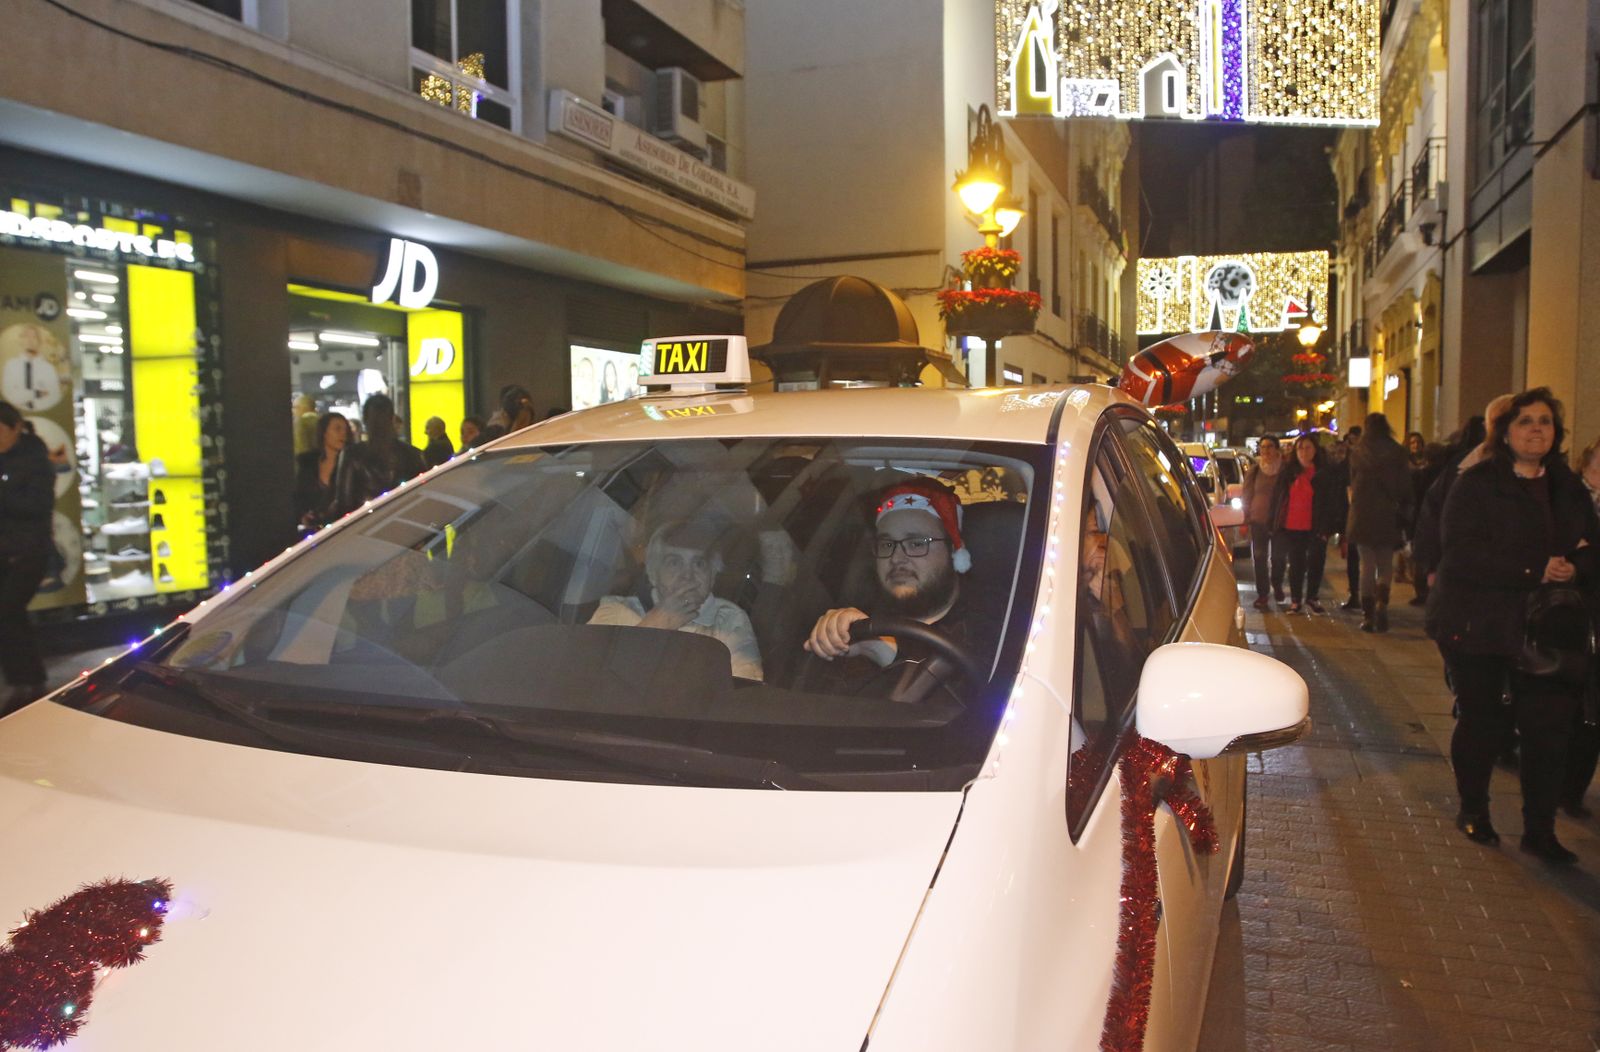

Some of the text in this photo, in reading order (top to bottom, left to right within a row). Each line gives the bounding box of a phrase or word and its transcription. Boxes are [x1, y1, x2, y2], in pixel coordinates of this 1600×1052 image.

[372, 238, 439, 309] JD
[35, 298, 60, 316] JD
[409, 338, 454, 377] JD
[657, 342, 708, 373] TAXI
